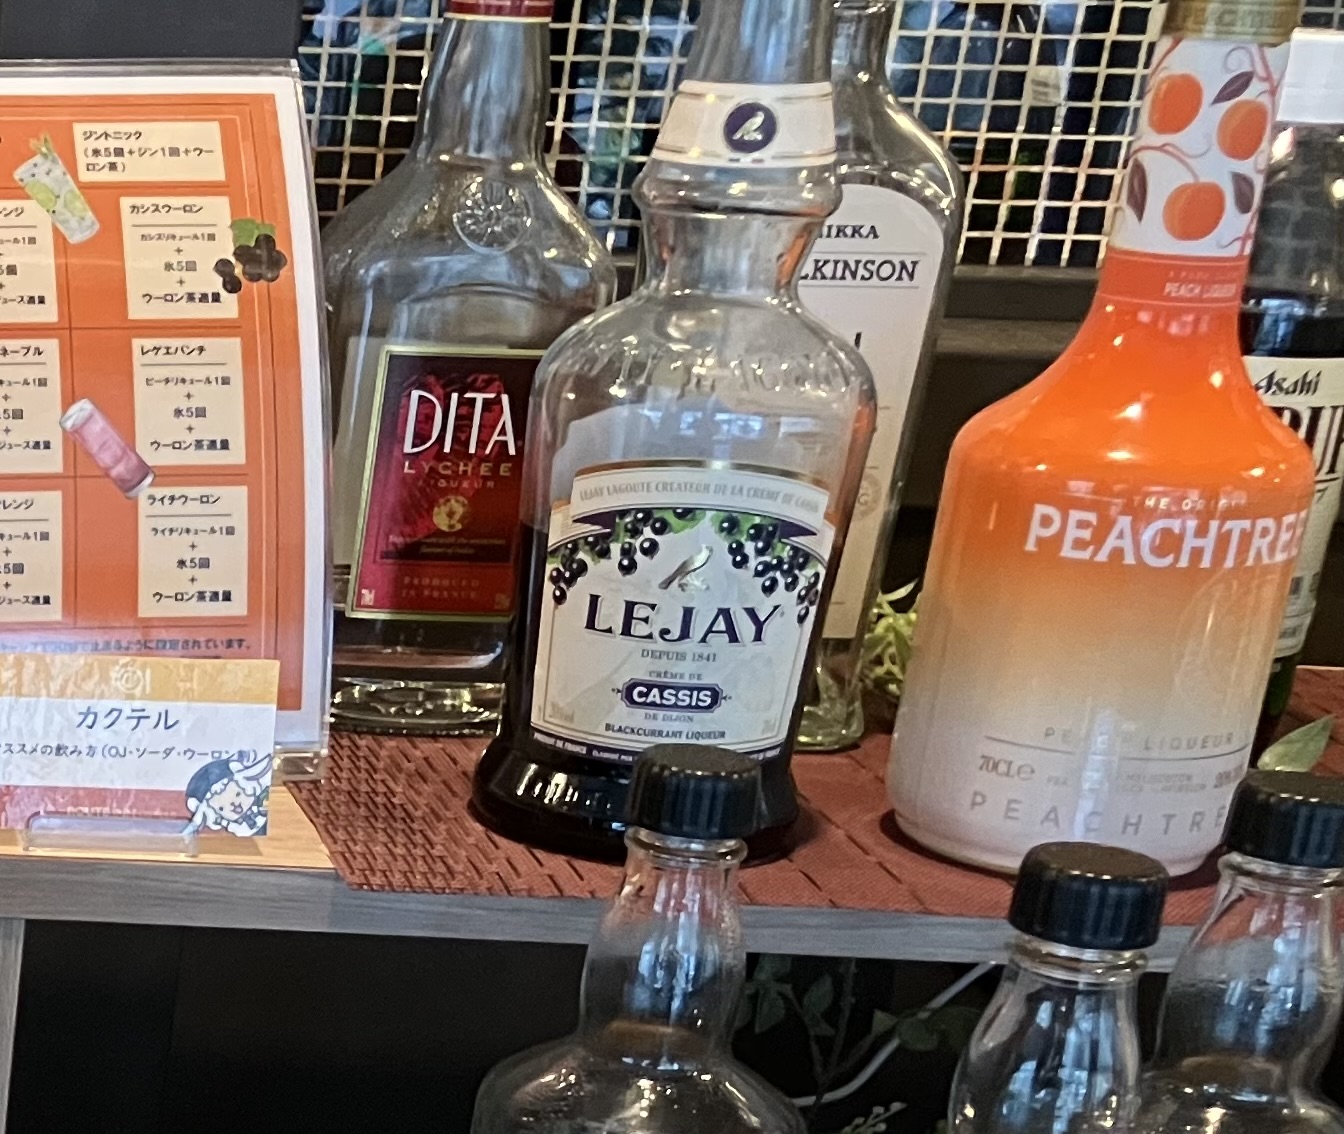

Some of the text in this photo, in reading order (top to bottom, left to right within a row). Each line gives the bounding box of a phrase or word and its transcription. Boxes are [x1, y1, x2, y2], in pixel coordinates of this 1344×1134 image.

[82, 129, 142, 142] ジントニック
[129, 203, 204, 215] カシスウーロン
[818, 224, 881, 240] IKKA
[800, 258, 921, 283] KINSON
[141, 292, 223, 304] ウーロン茶適量
[140, 344, 207, 356] レゲエパンチ
[1254, 368, 1323, 397] Asahi
[403, 389, 516, 456] DITA
[150, 439, 230, 452] ウーロン茶適量
[403, 460, 512, 477] LYCHEE
[146, 493, 221, 506] ライチウーロン
[1024, 502, 1310, 570] PEACHTREE
[152, 590, 233, 603] ウーロン茶適量
[584, 593, 783, 645] LEJAY
[640, 648, 717, 663] DEPUIS 1841
[632, 685, 712, 707] CASSIS
[76, 704, 180, 732] カクテル
[643, 712, 658, 721] DE
[604, 722, 727, 740] BLACKCURRANT LIQUEUR
[1143, 730, 1234, 751] LIQUEUR
[969, 790, 1227, 836] PEACHTRE
